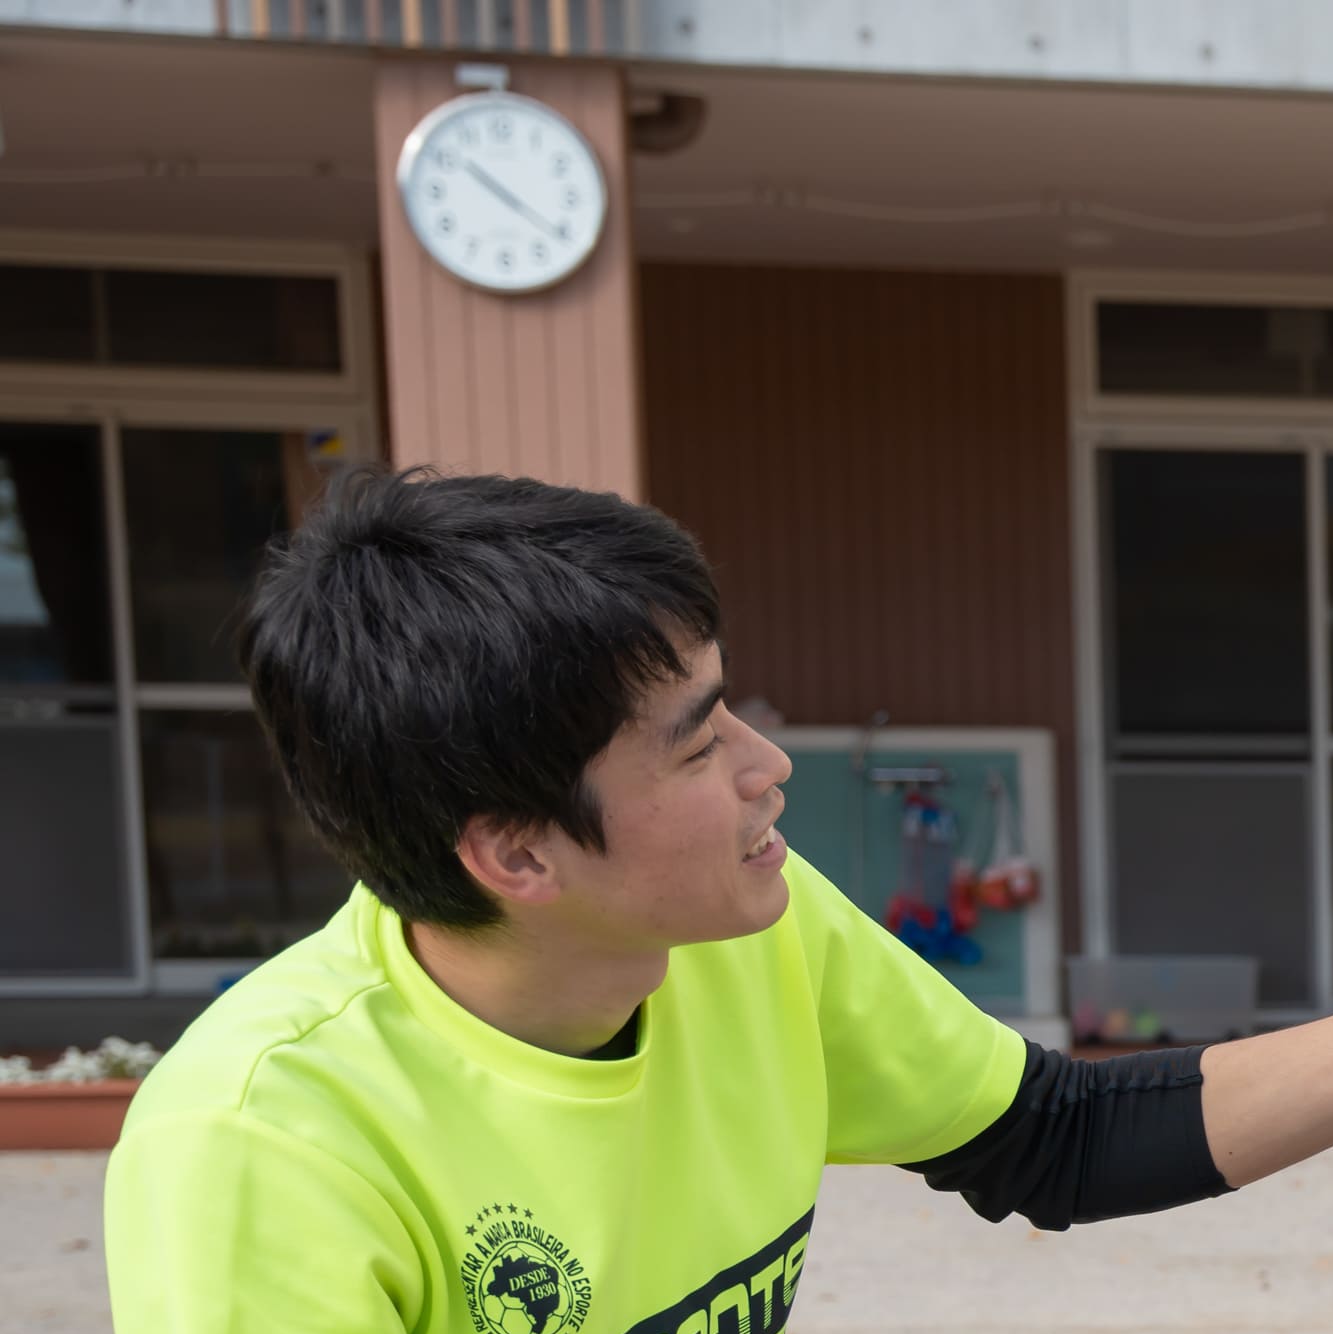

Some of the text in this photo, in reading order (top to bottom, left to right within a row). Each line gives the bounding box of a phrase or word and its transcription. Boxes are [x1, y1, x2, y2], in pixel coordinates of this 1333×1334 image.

[475, 1242, 492, 1259] A
[511, 1220, 570, 1262] BRASILEIRA
[563, 1258, 584, 1277] NO
[508, 1267, 551, 1292] DESDE
[529, 1282, 557, 1302] 1930
[568, 1277, 592, 1333] ESPORTE
